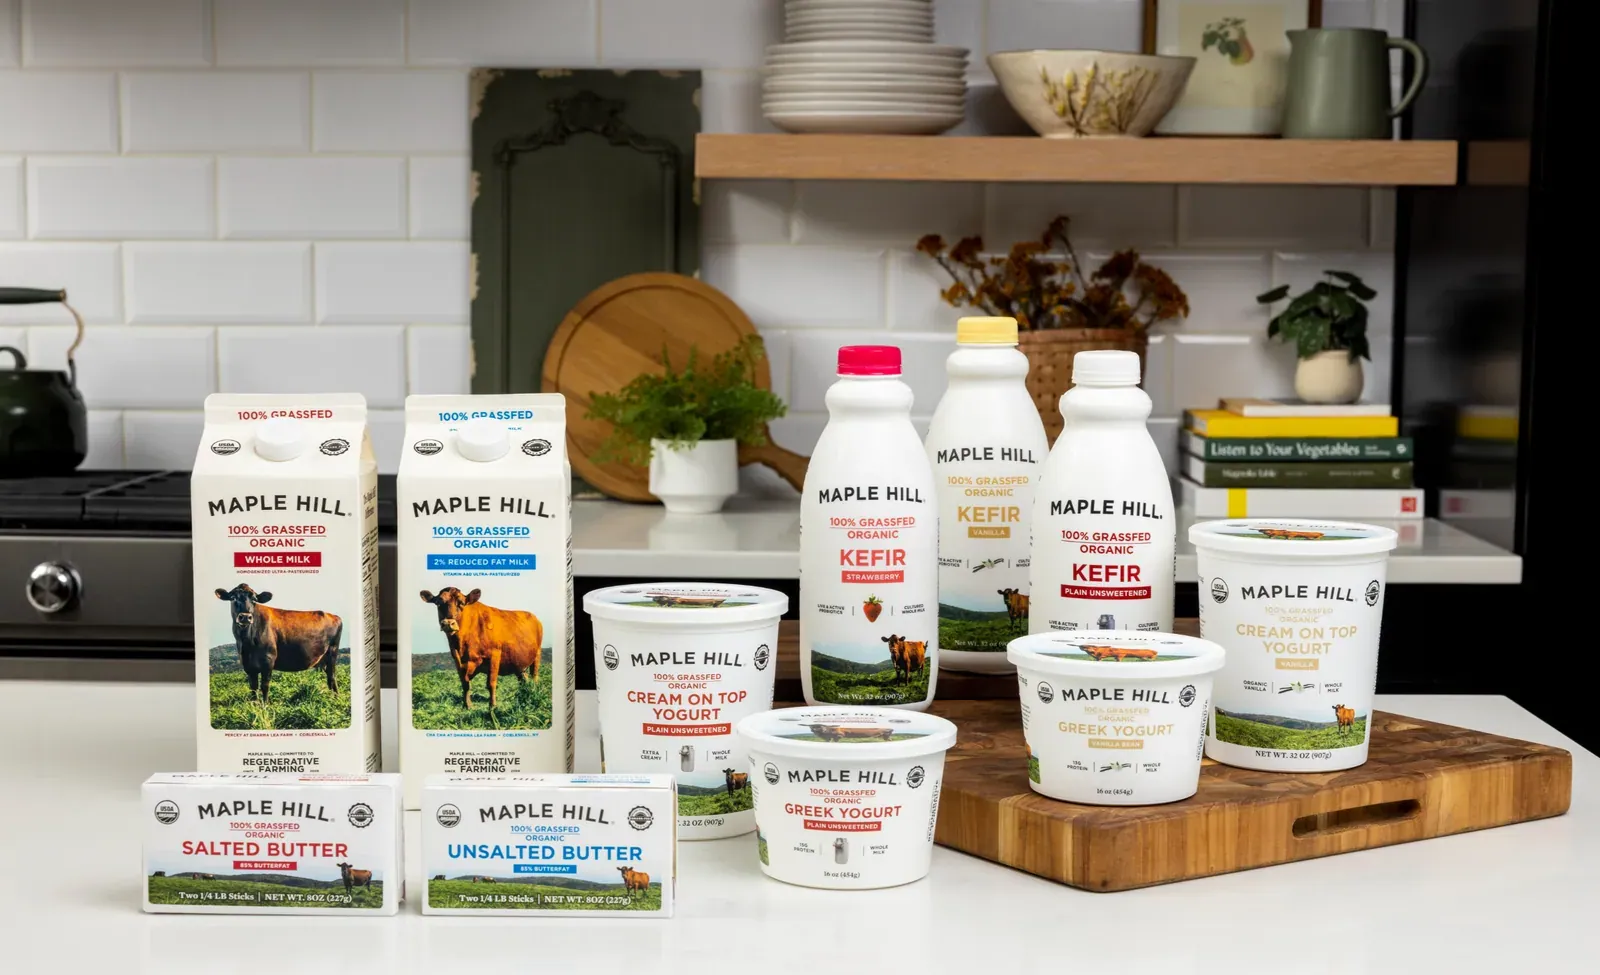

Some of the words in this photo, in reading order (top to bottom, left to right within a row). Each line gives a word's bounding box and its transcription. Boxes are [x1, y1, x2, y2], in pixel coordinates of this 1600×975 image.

[238, 411, 268, 420] 100%
[438, 412, 468, 421] 100%
[937, 447, 994, 464] MAPLE
[1001, 447, 1035, 464] HILL
[1211, 442, 1246, 457] Listen
[1250, 444, 1263, 456] to
[1265, 443, 1292, 456] Your
[1296, 442, 1360, 459] Vegetables
[948, 476, 973, 485] 100%
[976, 476, 1028, 485] GRASSFED
[819, 486, 879, 504] MAPLE
[886, 486, 923, 503] HILL
[964, 488, 1014, 497] ORGANIC
[208, 495, 287, 516] MAPLE
[297, 495, 346, 517] HILL
[412, 496, 491, 517] MAPLE
[500, 496, 549, 518] HILL
[1050, 500, 1114, 516] MAPLE
[958, 506, 1020, 523] KEFIR
[830, 517, 856, 527] 100%
[859, 517, 915, 527] GRASSFED
[228, 526, 258, 534] 100%
[262, 526, 326, 534] GRASSFED
[432, 526, 463, 535] 100%
[466, 526, 530, 535] GRASSFED
[847, 530, 899, 539] ORGANIC
[1061, 530, 1089, 540] 100%
[1092, 532, 1151, 542] GRASSFED
[250, 538, 305, 548] ORGANIC
[454, 539, 509, 548] ORGANIC
[1080, 545, 1134, 555] ORGANIC
[245, 556, 283, 564] WHOLE
[286, 556, 310, 564] MILK
[840, 548, 906, 567] KEFIR
[1072, 564, 1141, 582] KEFIR
[1241, 585, 1308, 600] MAPLE
[1316, 586, 1354, 602] HILL
[1236, 624, 1293, 639] CREAM
[1299, 627, 1324, 639] ON
[1329, 626, 1357, 638] TOP
[1262, 642, 1332, 655] YOGURT
[631, 652, 696, 667] MAPLE
[704, 652, 743, 667] HILL
[627, 691, 682, 705] CREAM
[688, 693, 713, 705] ON
[718, 690, 747, 704] TOP
[1062, 688, 1124, 702] MAPLE
[1132, 689, 1170, 704] HILL
[653, 708, 721, 721] YOGURT
[670, 726, 728, 734] UNSWEETENED
[1058, 721, 1107, 735] GREEK
[1113, 724, 1174, 736] YOGURT
[242, 758, 320, 766] REGENERATIVE
[1312, 751, 1332, 760] (907g)
[787, 770, 850, 783] MAPLE
[858, 771, 897, 785] HILL
[198, 800, 273, 820] MAPLE
[282, 801, 329, 822] HILL
[479, 804, 553, 823] MAPLE
[562, 804, 609, 825] HILL
[785, 803, 833, 818] GREEK
[840, 805, 902, 819] YOGURT
[704, 818, 725, 827] (907g)
[182, 841, 260, 856] SALTED
[268, 843, 348, 857] BUTTER
[448, 844, 555, 860] UNSALTED
[563, 846, 642, 861] BUTTER
[200, 892, 214, 900] 1/4
[228, 892, 254, 901] Sticks
[327, 894, 352, 903] (227g)
[480, 895, 492, 903] 1/4
[508, 895, 534, 903] Sticks
[606, 896, 631, 906] (227g)
